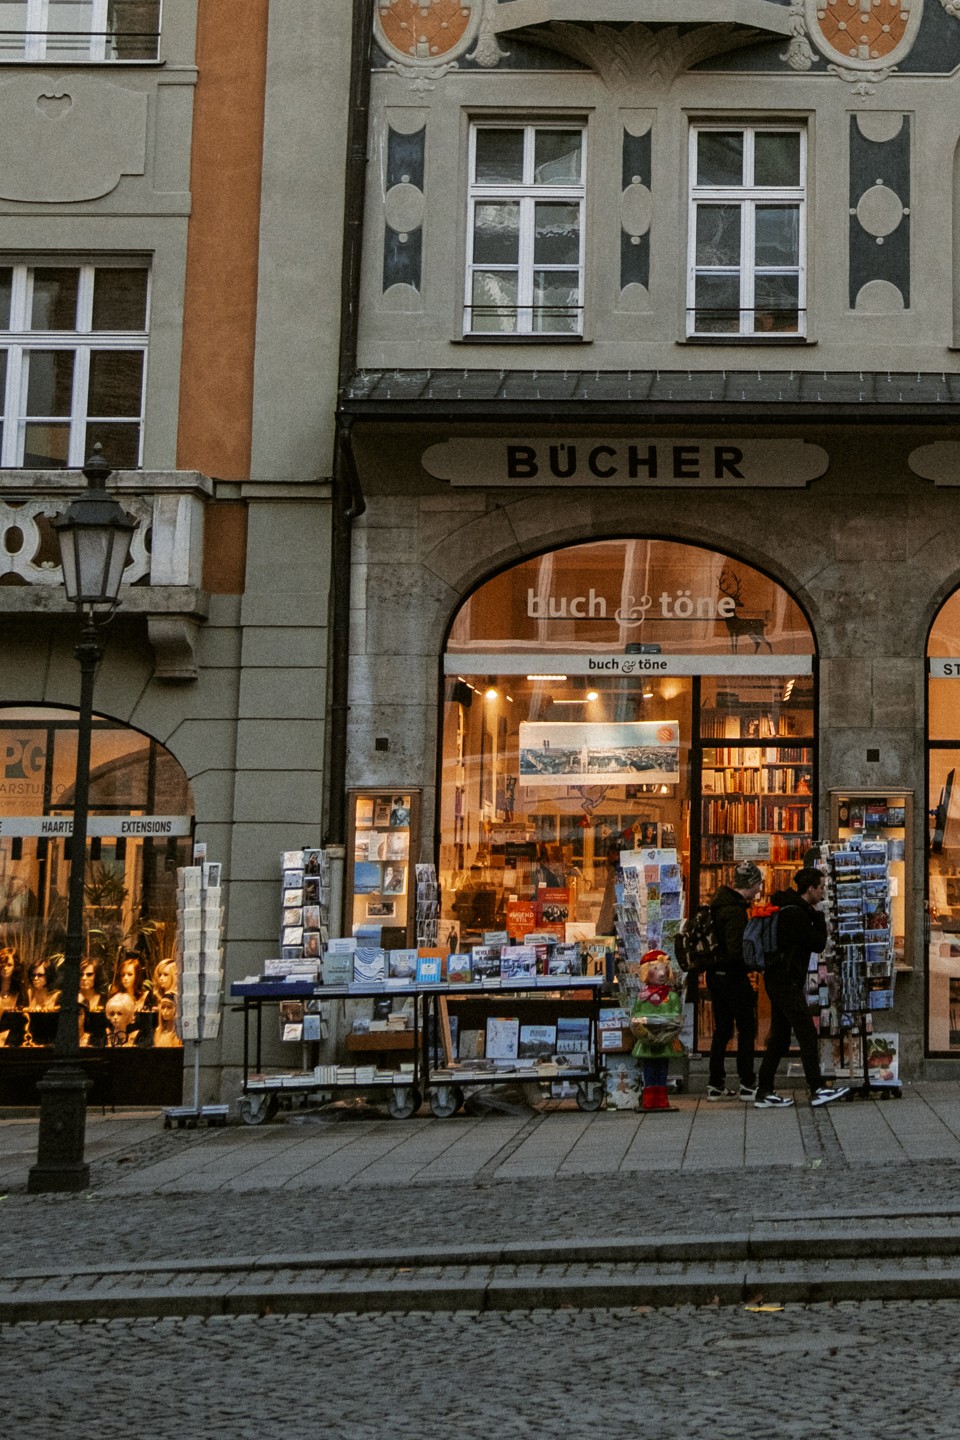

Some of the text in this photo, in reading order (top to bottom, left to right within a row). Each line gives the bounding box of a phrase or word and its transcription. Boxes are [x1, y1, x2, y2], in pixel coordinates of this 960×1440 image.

[507, 443, 745, 479] BÜCHER
[527, 588, 736, 628] buch & töne
[588, 658, 667, 673] buch & töne
[41, 821, 172, 833] HAARTE EXTENSIONS
